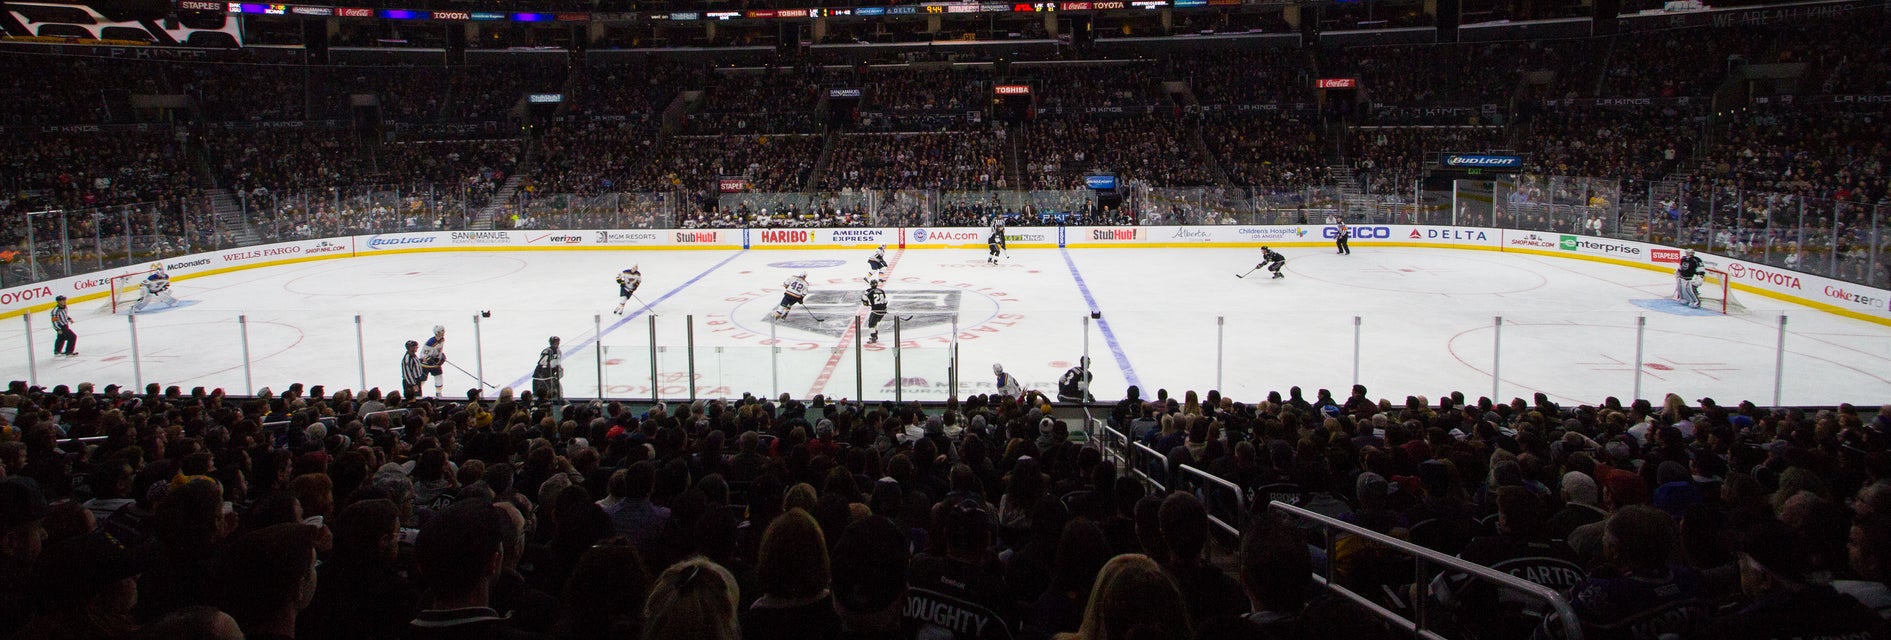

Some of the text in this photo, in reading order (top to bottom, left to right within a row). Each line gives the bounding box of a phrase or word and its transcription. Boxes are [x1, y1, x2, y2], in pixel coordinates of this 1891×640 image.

[182, 1, 220, 10] STAPLES
[1742, 10, 1770, 25] ARE
[451, 231, 510, 240] SAN MANUEL
[676, 231, 717, 243] StubHub!
[761, 230, 808, 243] HARIBO
[929, 231, 978, 240] AAA.com
[1093, 229, 1137, 240] StubHub!
[1171, 226, 1208, 239] Alberta
[1270, 227, 1297, 236] Hospital
[1322, 226, 1391, 239] GEICO
[1428, 229, 1487, 241] DELTA
[371, 236, 437, 246] BUD LIGHT
[550, 234, 582, 244] verizon
[1564, 239, 1641, 255] enterprise
[223, 245, 301, 262] WELLS FARGO
[1652, 252, 1679, 260] STAPLES
[166, 258, 211, 271] McDonald's
[1748, 267, 1801, 290] TOYOTA
[74, 279, 98, 291] Coke
[790, 281, 805, 293] 42
[0, 286, 52, 305] OYOTA
[1824, 285, 1884, 308] Coke zero
